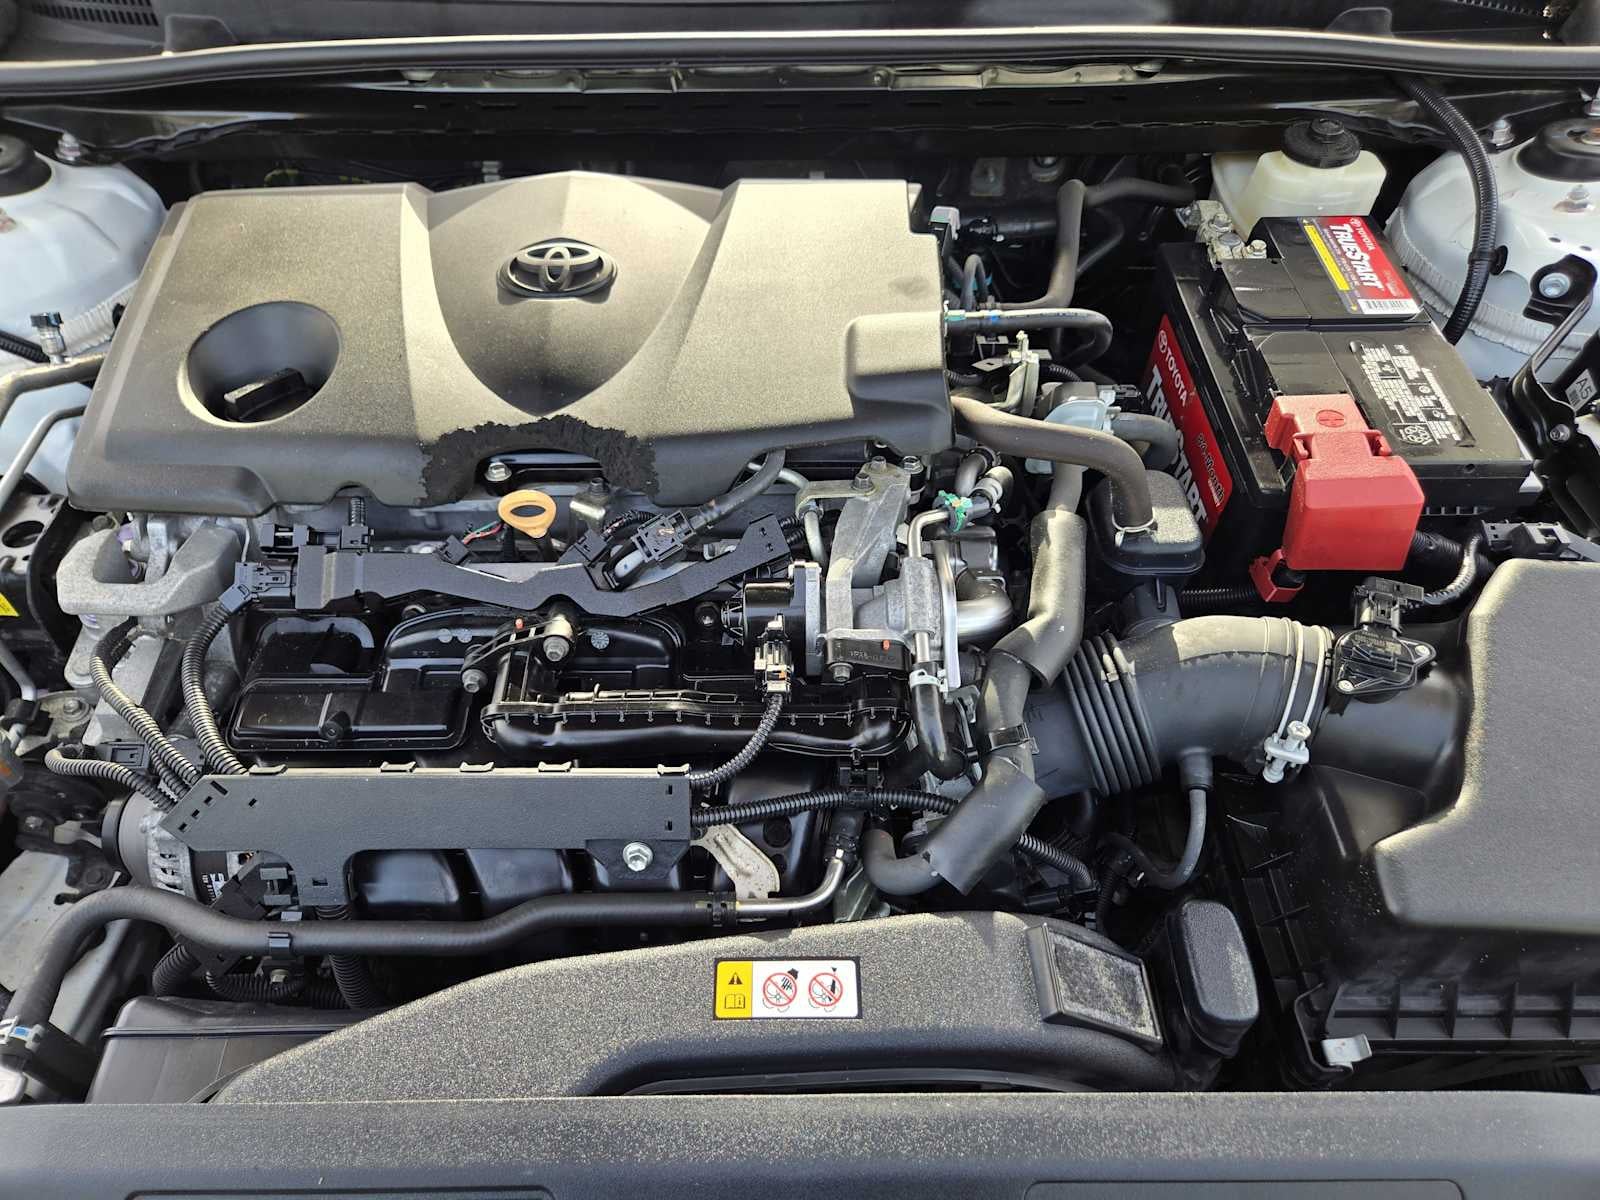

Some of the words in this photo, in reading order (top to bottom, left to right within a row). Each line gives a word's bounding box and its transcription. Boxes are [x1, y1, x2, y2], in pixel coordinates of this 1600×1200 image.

[1329, 223, 1385, 291] TRUESTART
[1356, 226, 1376, 251] TOYOTA
[1166, 347, 1187, 407] TOYOTA
[1576, 378, 1593, 400] A5
